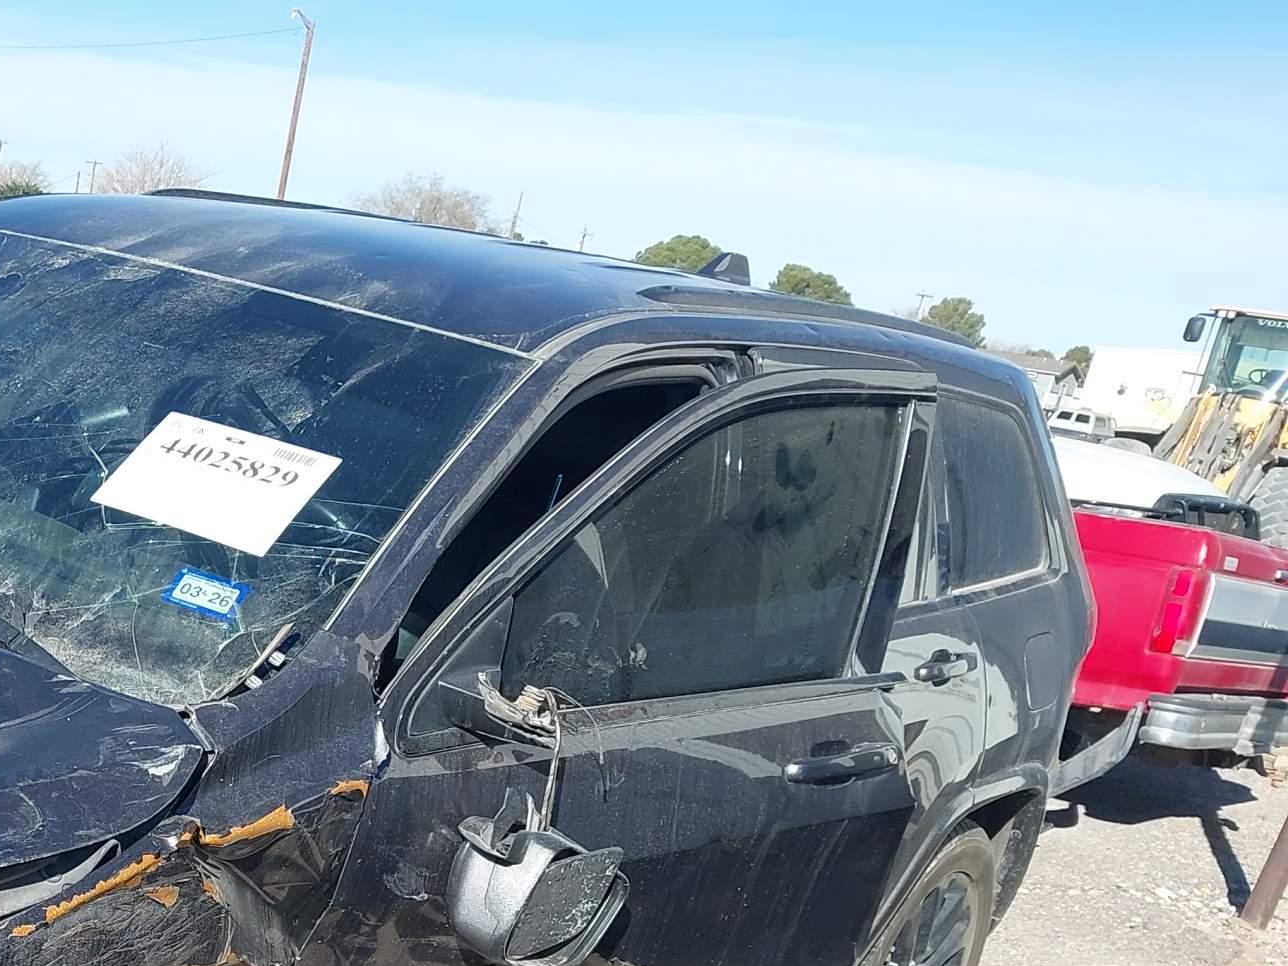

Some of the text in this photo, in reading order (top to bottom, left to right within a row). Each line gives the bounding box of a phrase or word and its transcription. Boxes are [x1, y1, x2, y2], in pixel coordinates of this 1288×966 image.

[160, 438, 299, 487] 44025829
[180, 583, 203, 598] 03
[208, 592, 233, 608] 26
